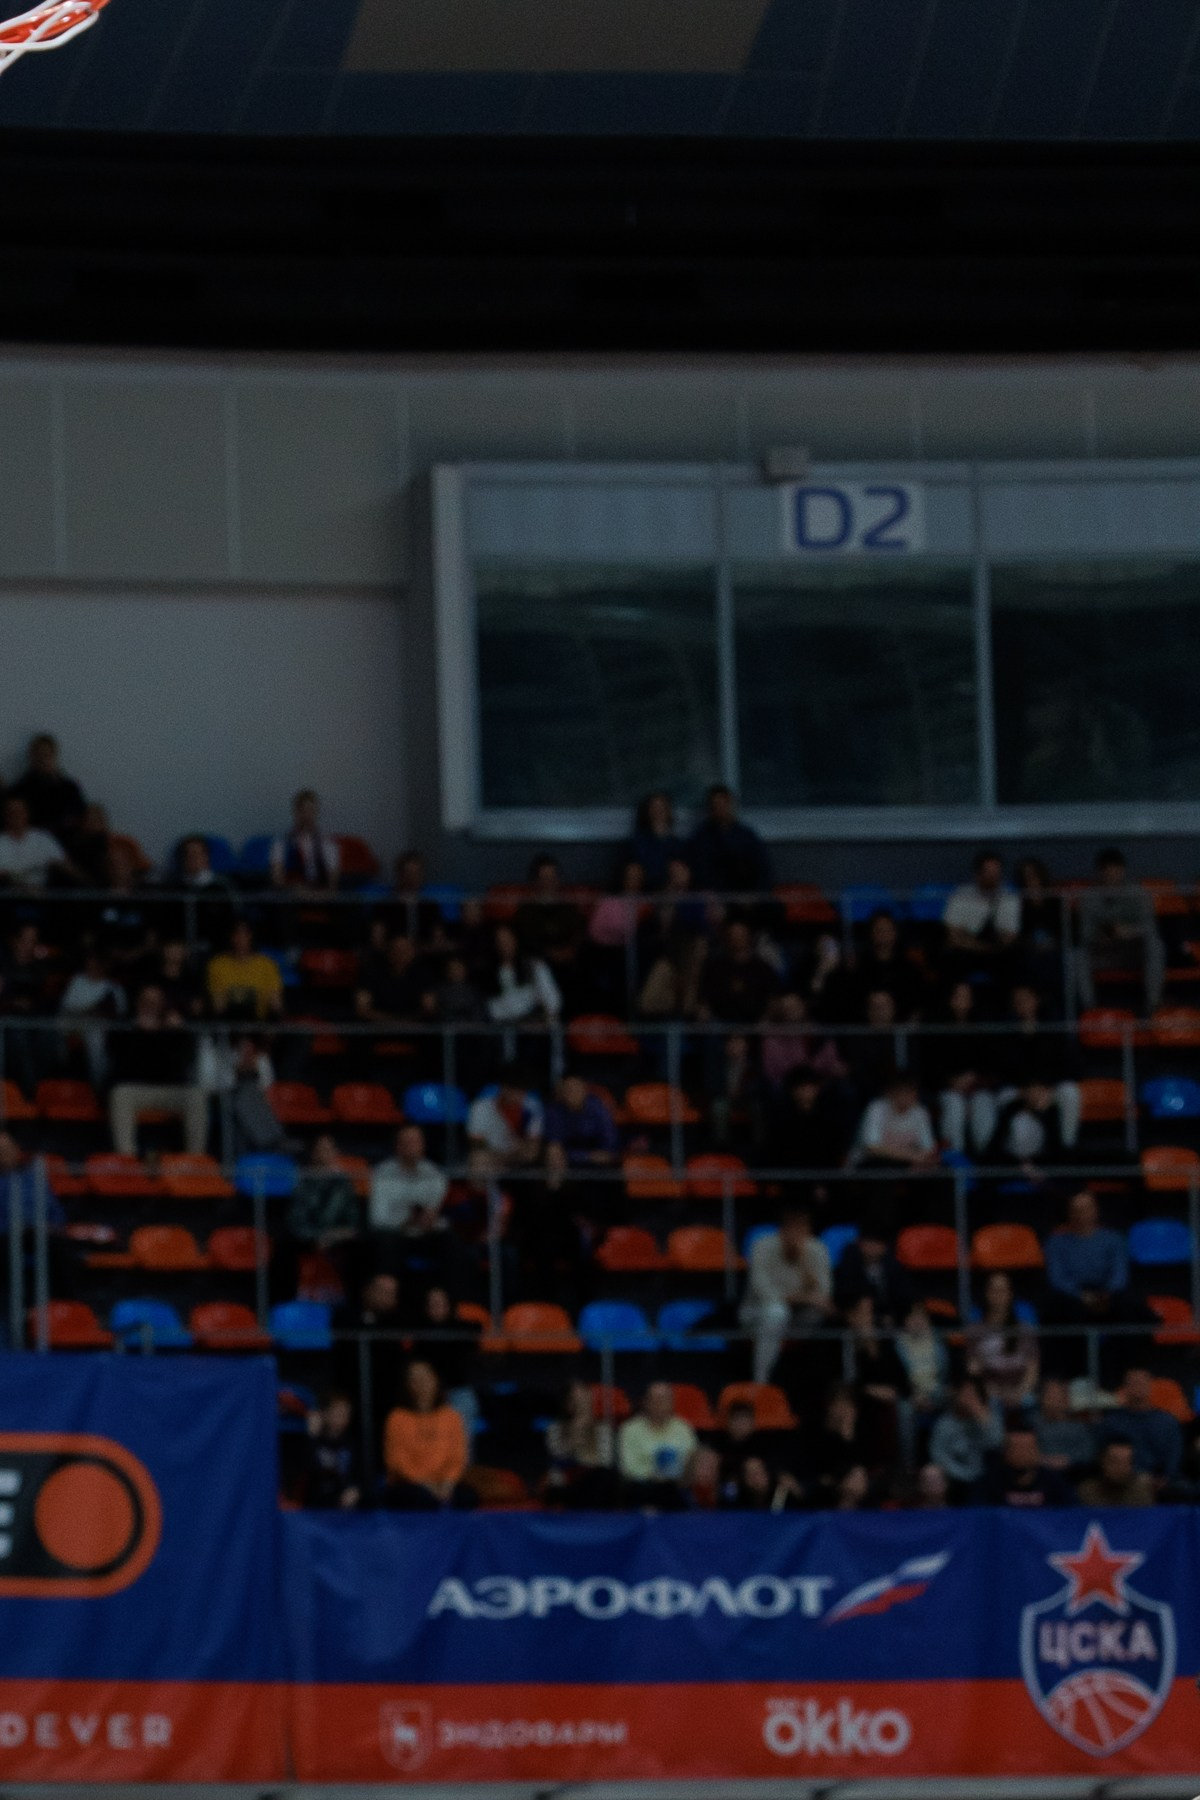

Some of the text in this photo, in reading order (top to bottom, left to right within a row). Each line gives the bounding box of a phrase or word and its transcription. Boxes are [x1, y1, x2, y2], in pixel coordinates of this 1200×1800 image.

[793, 486, 911, 551] D2
[427, 1575, 835, 1620] АЭРОФЛОТ
[1039, 1620, 1157, 1669] ЦСКА
